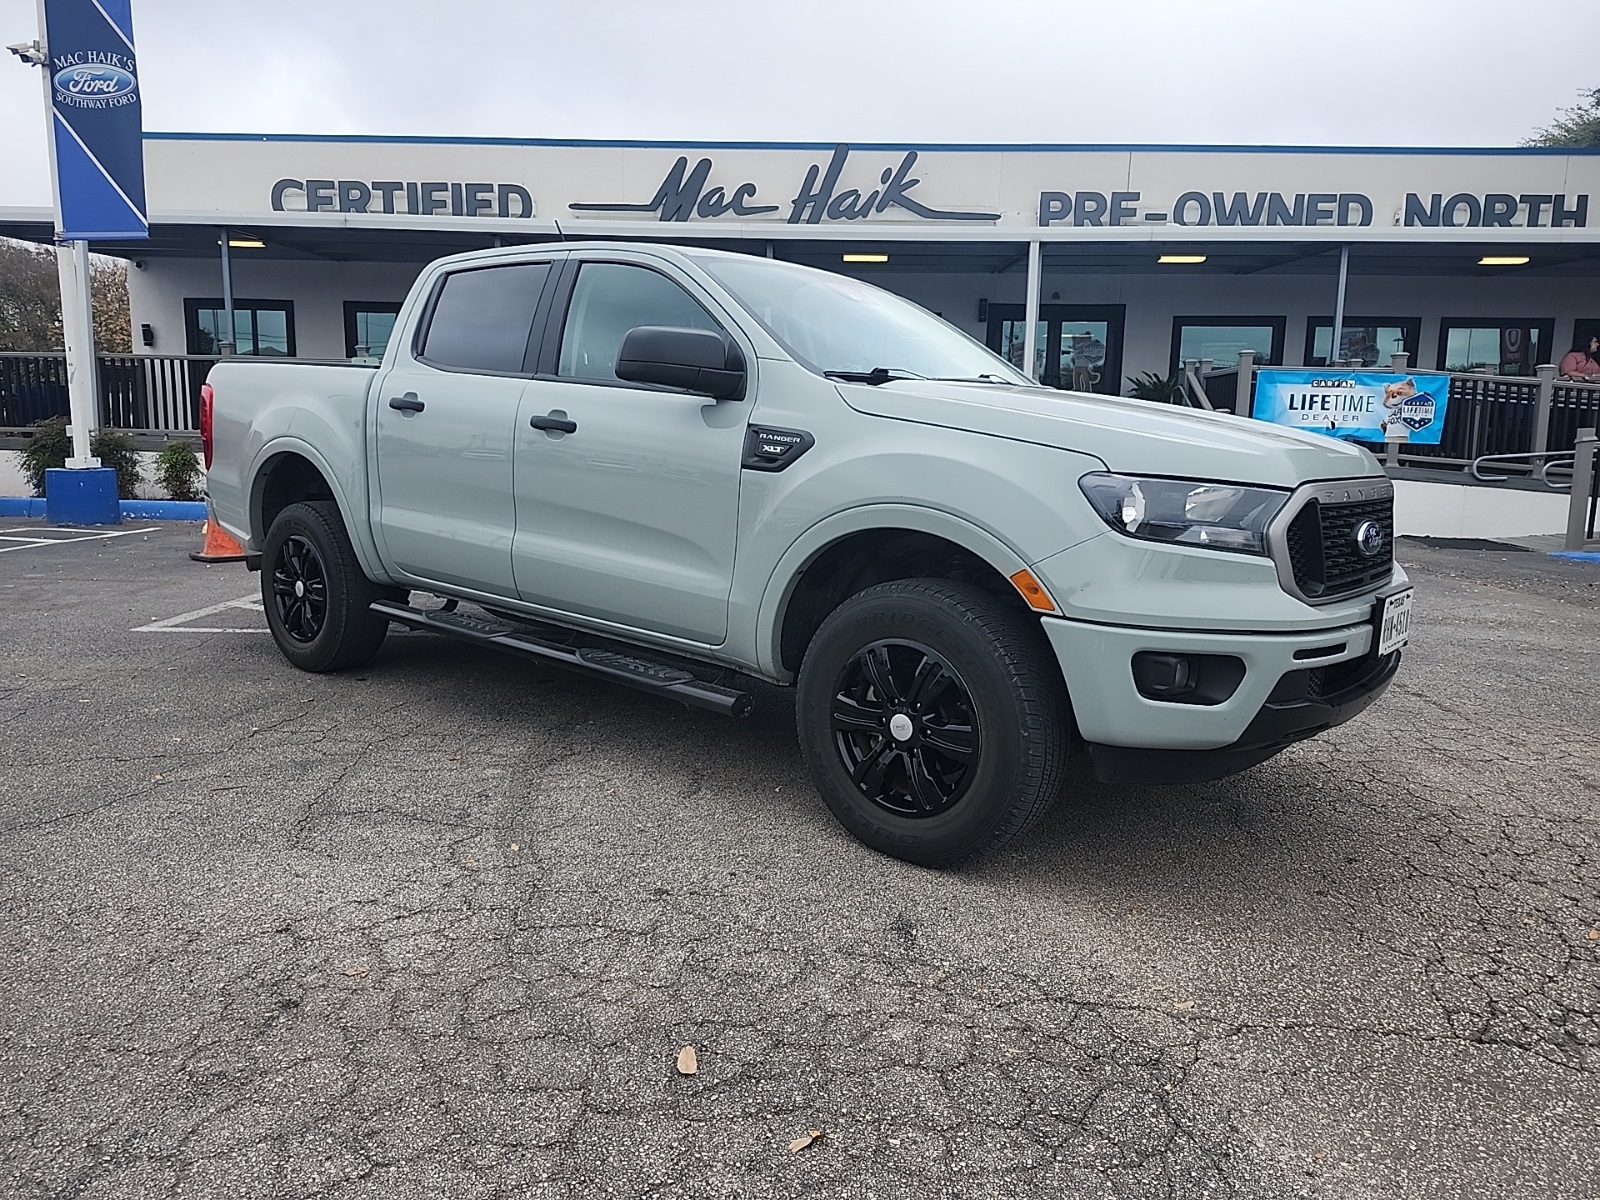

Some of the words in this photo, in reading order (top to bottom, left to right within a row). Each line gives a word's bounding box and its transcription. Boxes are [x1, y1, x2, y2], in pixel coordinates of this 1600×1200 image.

[53, 51, 84, 70] MAC
[87, 51, 135, 72] HAIK'S
[69, 70, 119, 93] Ford
[55, 92, 107, 108] SOUTHWAY
[109, 92, 137, 108] FORD
[640, 156, 779, 223] Mac
[787, 144, 928, 225] Haik
[270, 178, 534, 218] CERTIFIED
[1404, 192, 1589, 228] NORTH
[1311, 379, 1357, 389] CARFAX
[1288, 393, 1376, 413] LIFETIME
[1402, 406, 1434, 414] LIFETIME
[1301, 414, 1360, 422] DEALER
[759, 433, 801, 443] RANGER
[762, 444, 784, 452] XLT
